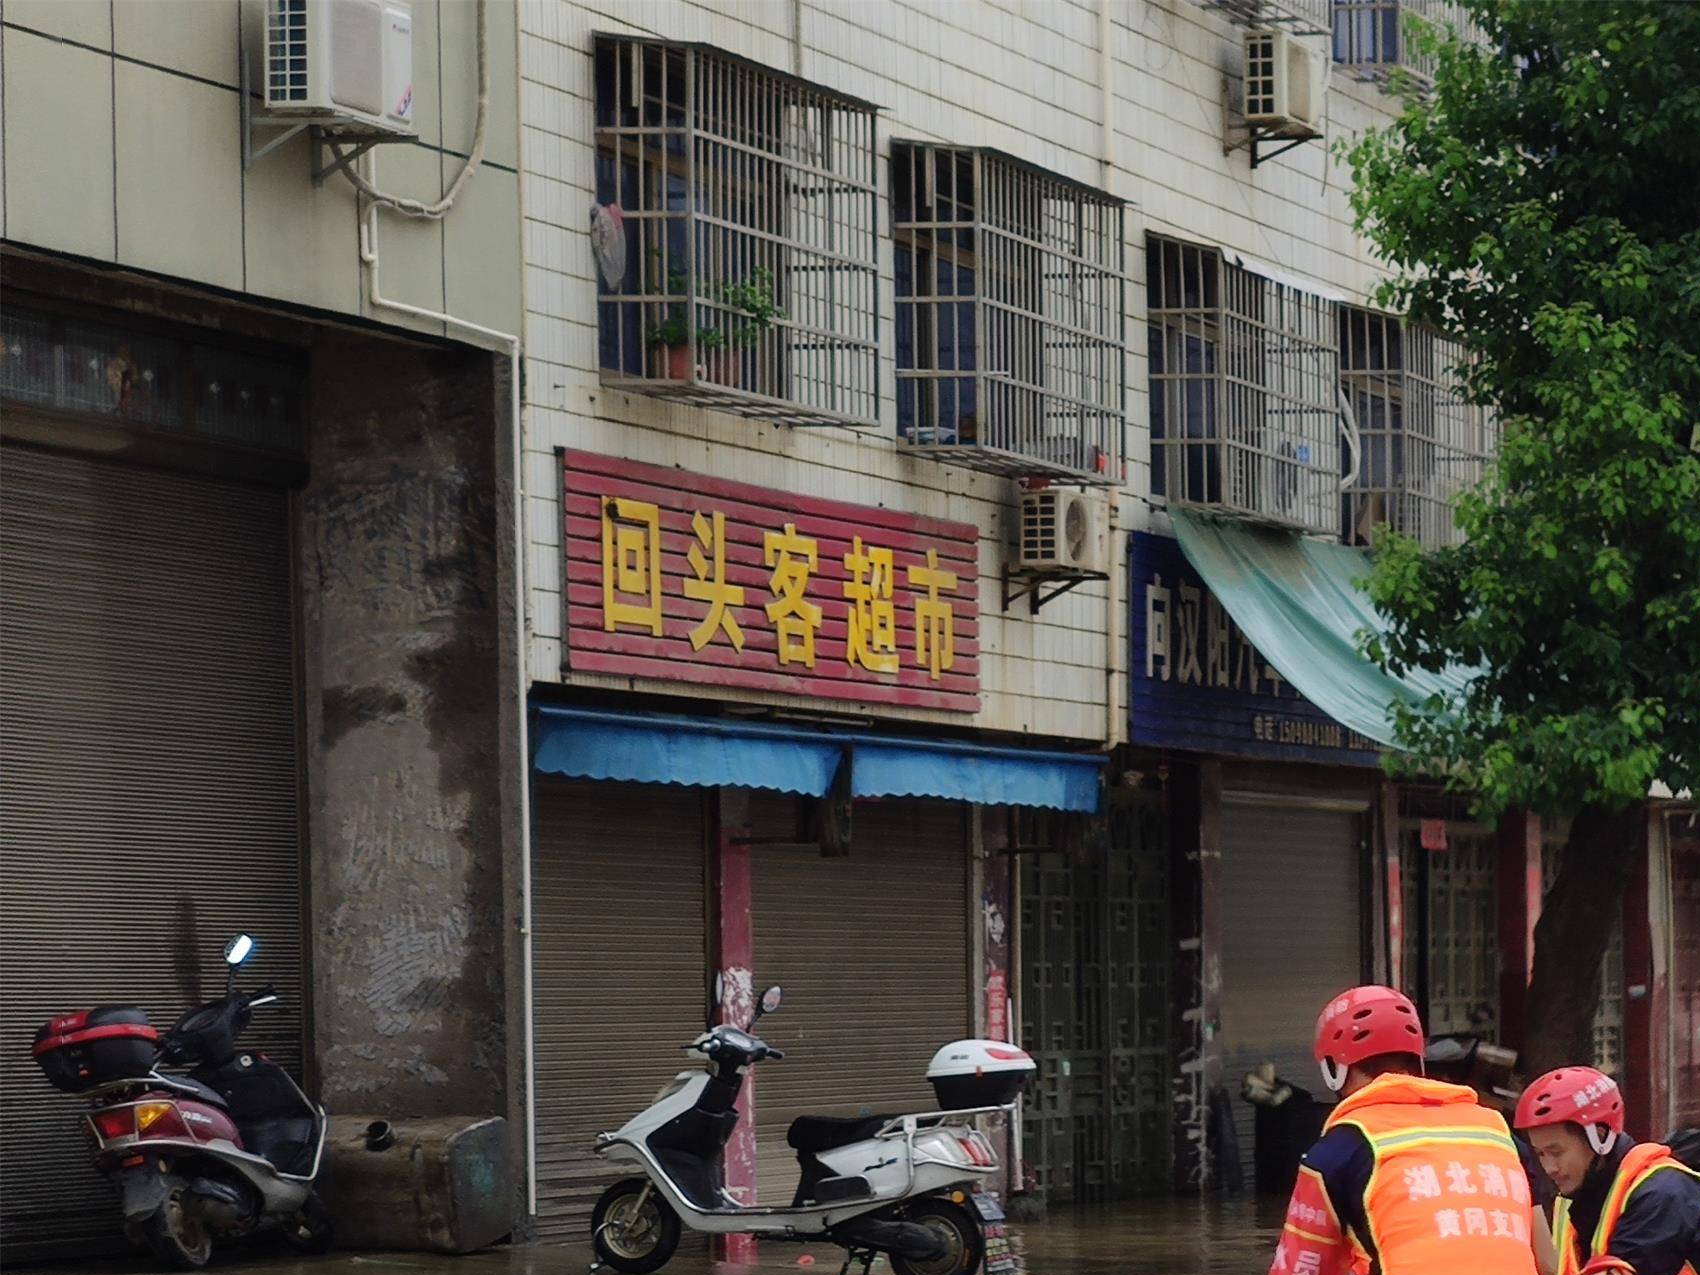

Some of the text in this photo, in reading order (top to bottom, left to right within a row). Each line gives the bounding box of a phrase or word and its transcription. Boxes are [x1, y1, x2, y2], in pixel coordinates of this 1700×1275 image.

[600, 494, 957, 682] 回头客超市
